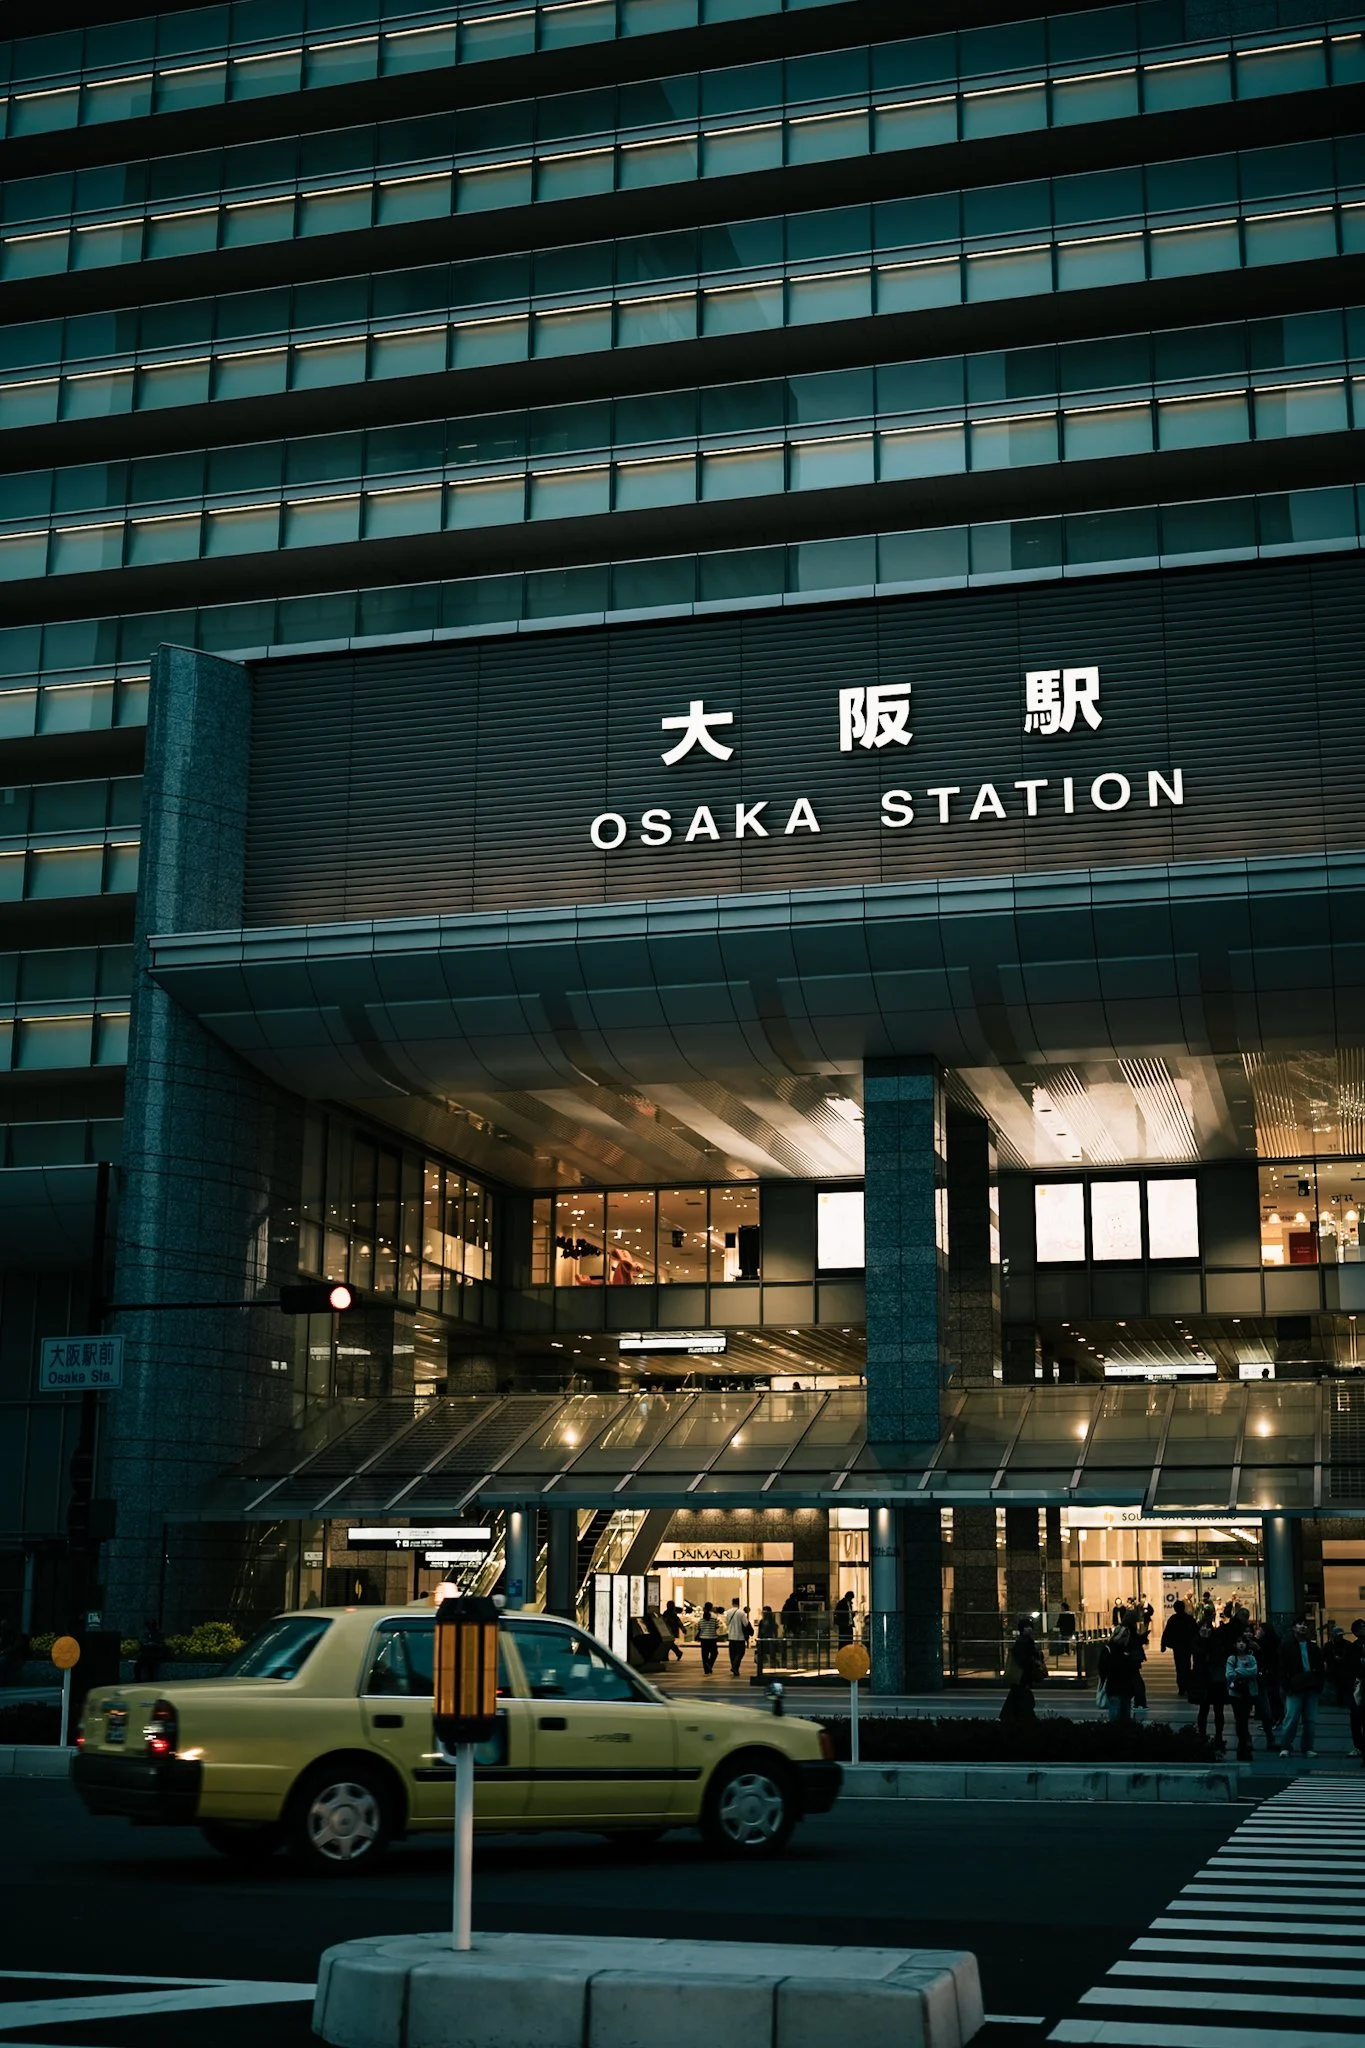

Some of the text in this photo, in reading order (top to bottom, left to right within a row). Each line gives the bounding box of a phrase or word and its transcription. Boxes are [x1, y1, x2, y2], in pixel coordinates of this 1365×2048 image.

[660, 666, 1103, 766] 大阪駅
[590, 768, 1184, 850] OSAKA STATION
[49, 1342, 114, 1368] 大阪駅前
[48, 1369, 113, 1384] Osaka Sta.
[673, 1549, 741, 1560] DAIMARU
